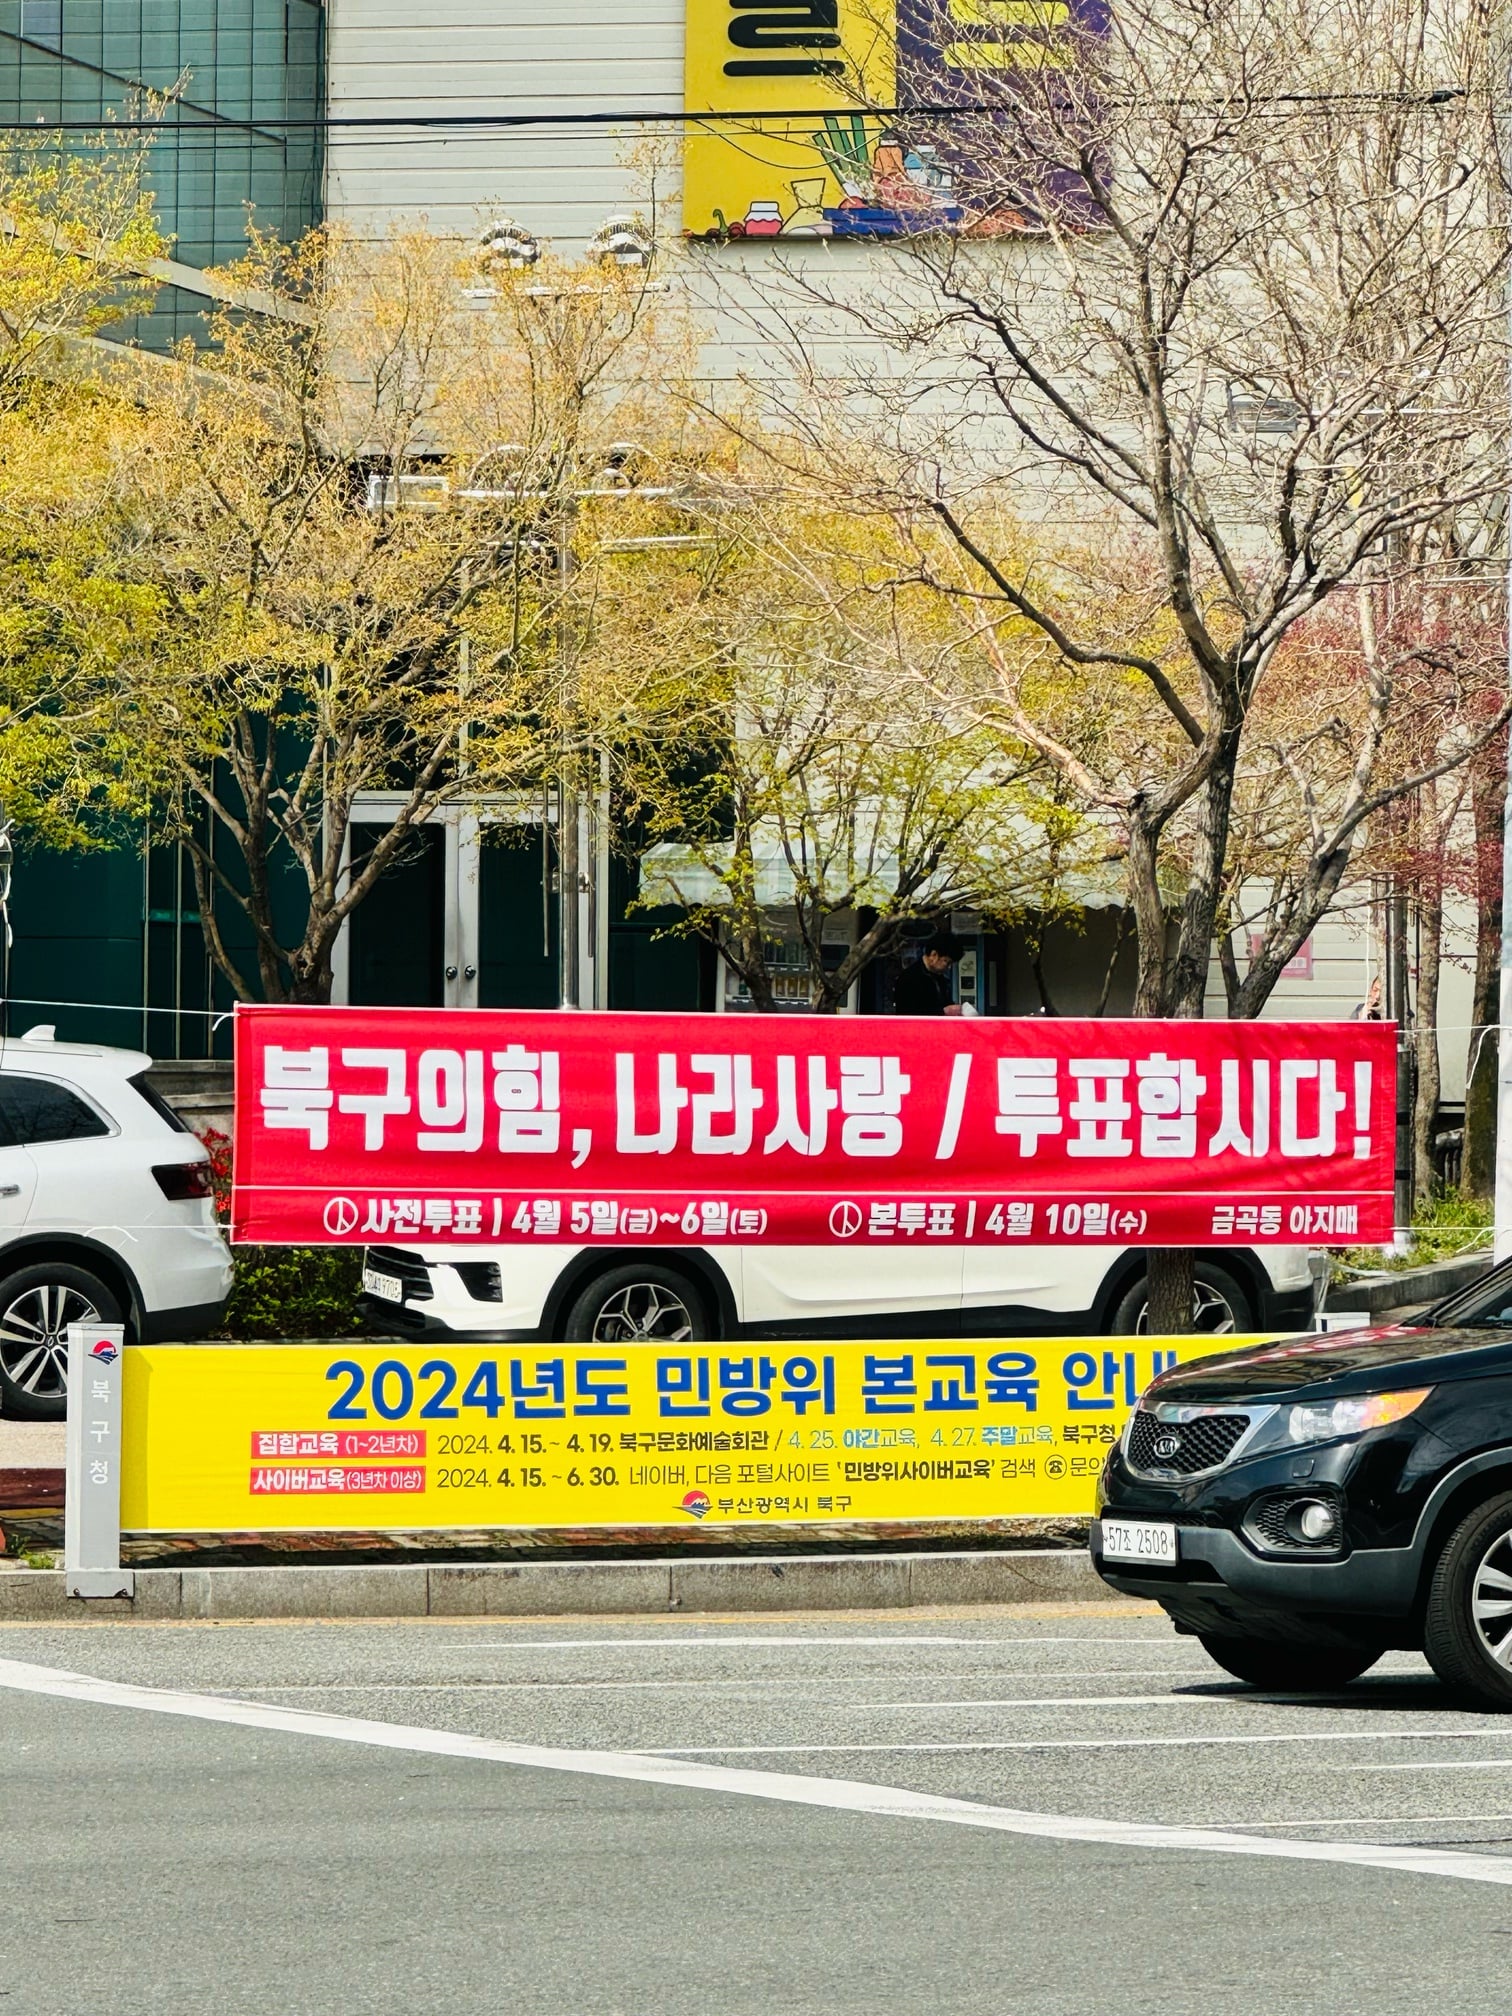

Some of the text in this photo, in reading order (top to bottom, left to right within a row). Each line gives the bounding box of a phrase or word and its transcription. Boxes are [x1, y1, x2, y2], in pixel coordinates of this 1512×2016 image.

[260, 1044, 1373, 1169] 북구의힘, 나라사랑 / 투표합시다!
[360, 1198, 482, 1235] 사전투표
[511, 1200, 561, 1235] 4월
[570, 1200, 768, 1236] 5일(금)~6일(토)
[868, 1202, 956, 1236] 본투표
[985, 1203, 1034, 1236] 4월
[1046, 1203, 1147, 1236] 10일(수)
[1211, 1204, 1358, 1236] 금곡동 아지매
[326, 1359, 631, 1419] 2024년도
[656, 1355, 836, 1417] 민방위
[861, 1352, 1040, 1414] 본교육
[90, 1380, 111, 1484] 북구청
[258, 1433, 419, 1454] 집합교육 (1~2년차)
[437, 1434, 493, 1454] 2024.
[619, 1430, 769, 1452] 북구문화예술회관
[842, 1428, 920, 1449] 야간교육,
[981, 1425, 1058, 1448] 주말교육,
[1062, 1423, 1117, 1446] 북구청
[436, 1468, 492, 1489] 2024.
[630, 1465, 690, 1487] 네이버,
[695, 1464, 732, 1485] 다음
[737, 1462, 830, 1484] 포털사이트
[1001, 1458, 1036, 1480] 검색
[717, 1495, 853, 1515] 부산광역시 북구
[1108, 1526, 1168, 1555] 57조 2508
